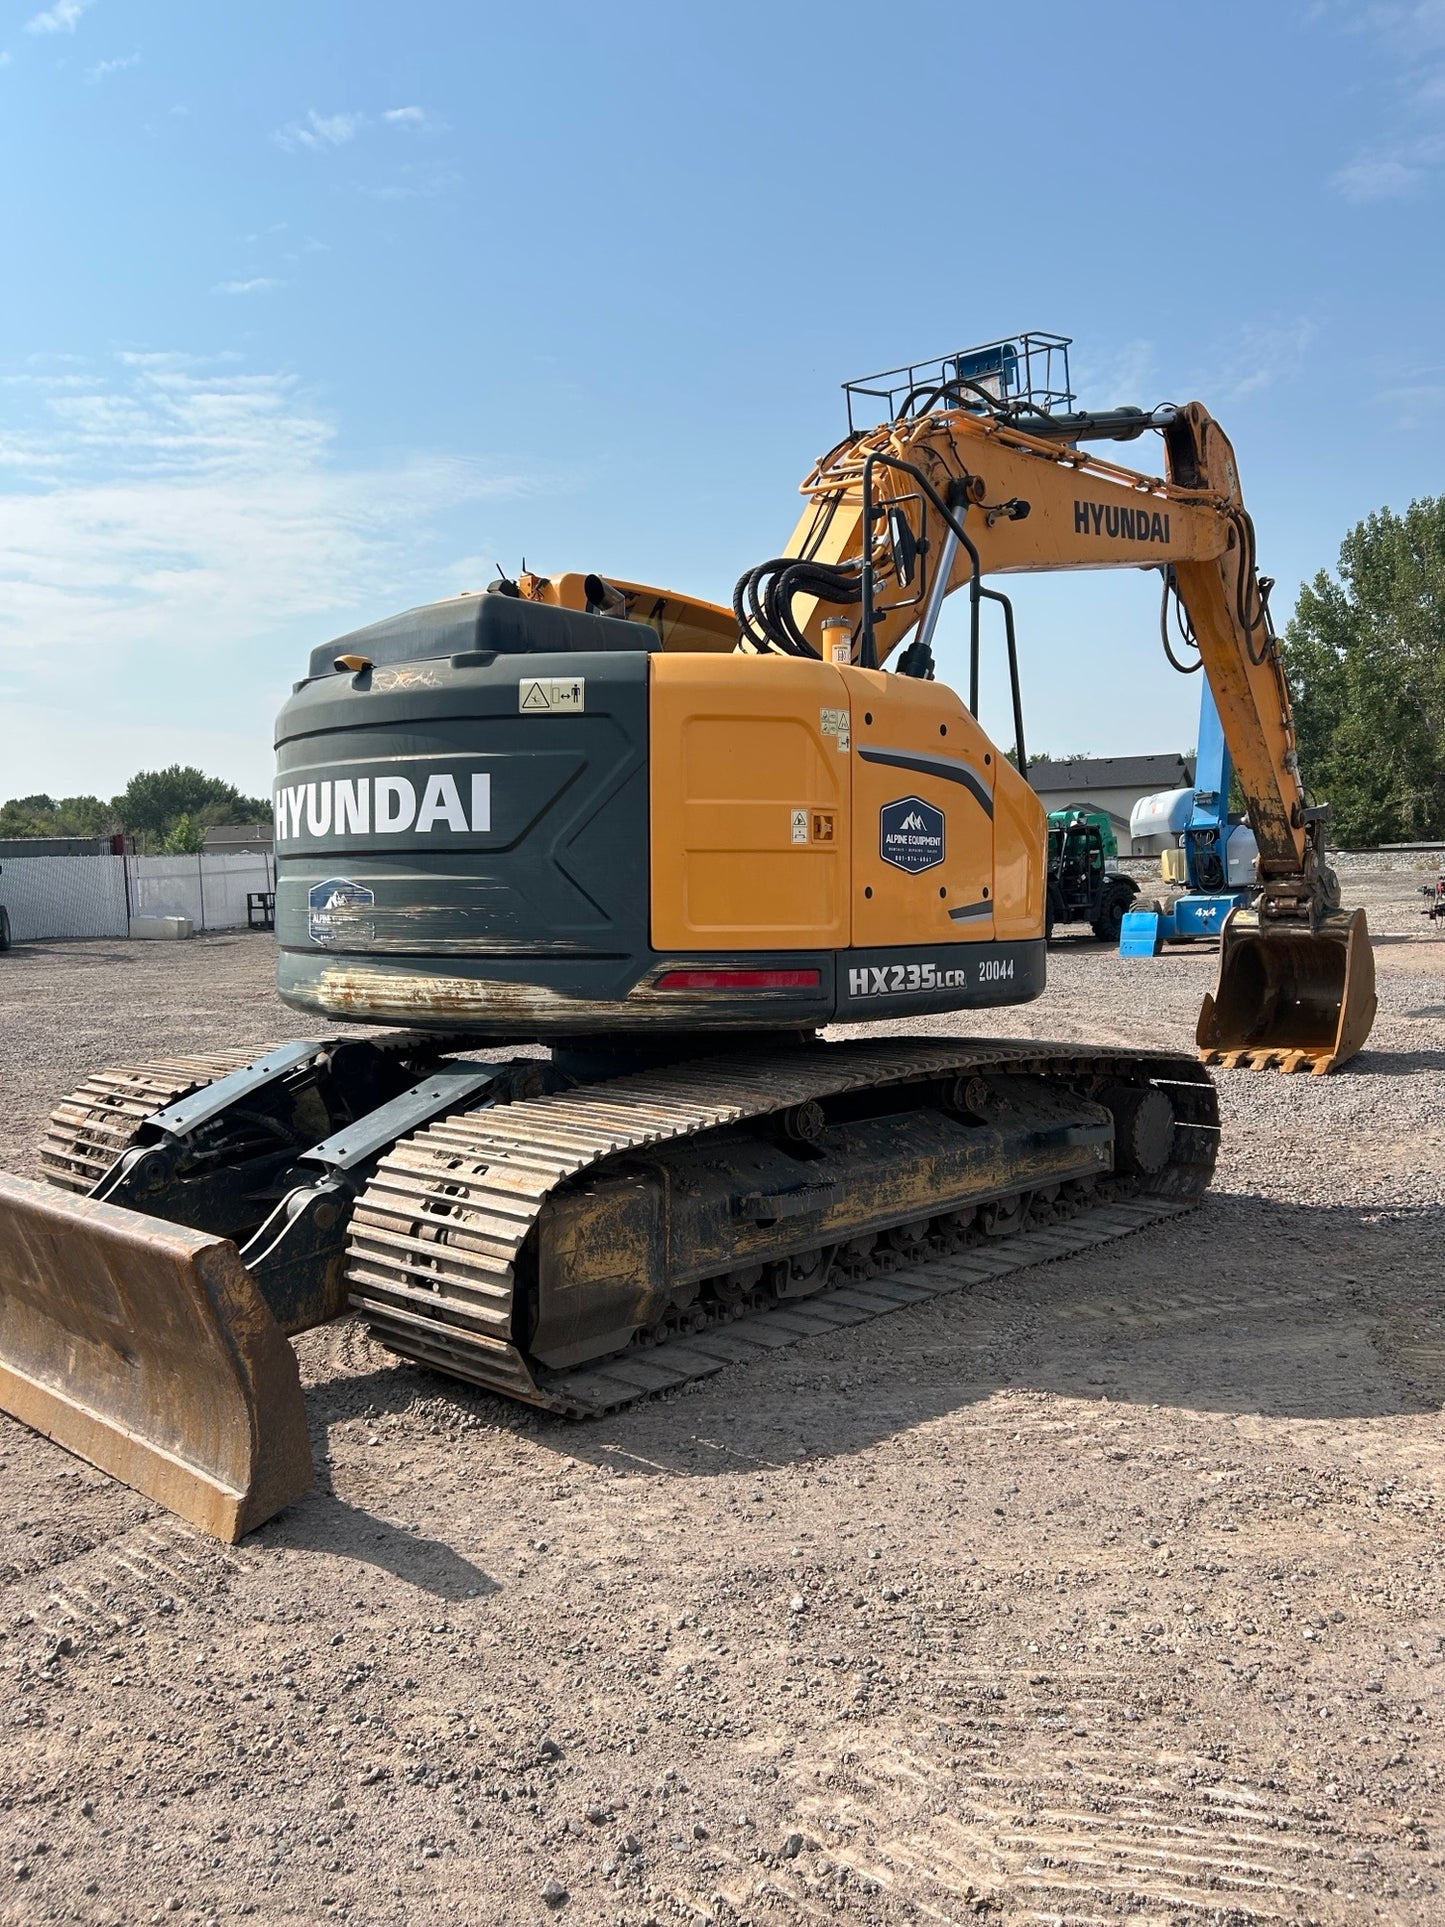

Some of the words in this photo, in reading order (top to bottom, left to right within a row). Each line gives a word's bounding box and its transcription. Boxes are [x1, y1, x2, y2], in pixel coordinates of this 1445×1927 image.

[1074, 500, 1170, 544] HYUNDAI
[276, 773, 491, 841] HYUNDAI
[886, 834, 908, 845] ALPINE
[908, 835, 941, 847] EQUIPMENT
[1195, 907, 1217, 918] 4x4
[848, 963, 966, 998] HX235LCR
[979, 959, 1015, 982] 20044
